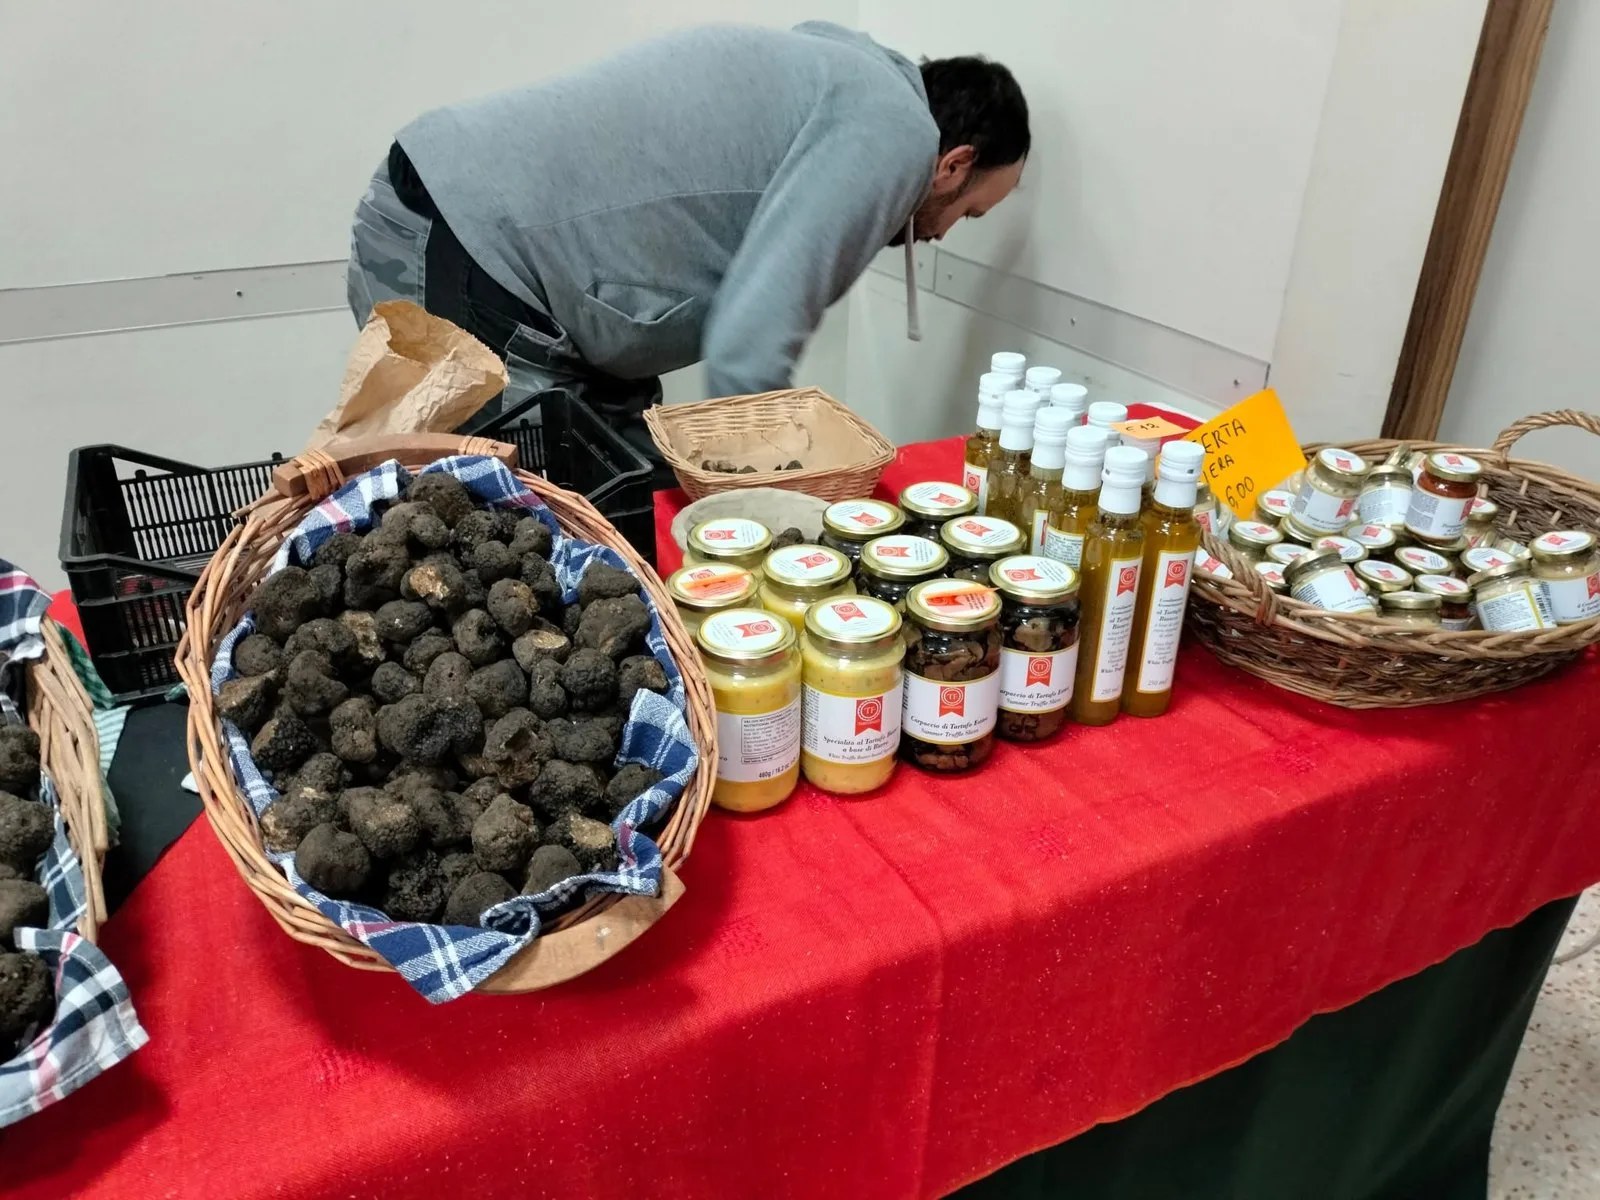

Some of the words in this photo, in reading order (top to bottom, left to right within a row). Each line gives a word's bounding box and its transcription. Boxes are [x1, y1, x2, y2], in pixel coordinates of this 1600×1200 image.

[1198, 418, 1247, 454] ERTA
[1225, 476, 1255, 510] 6,00
[1000, 688, 1027, 698] arpaccio
